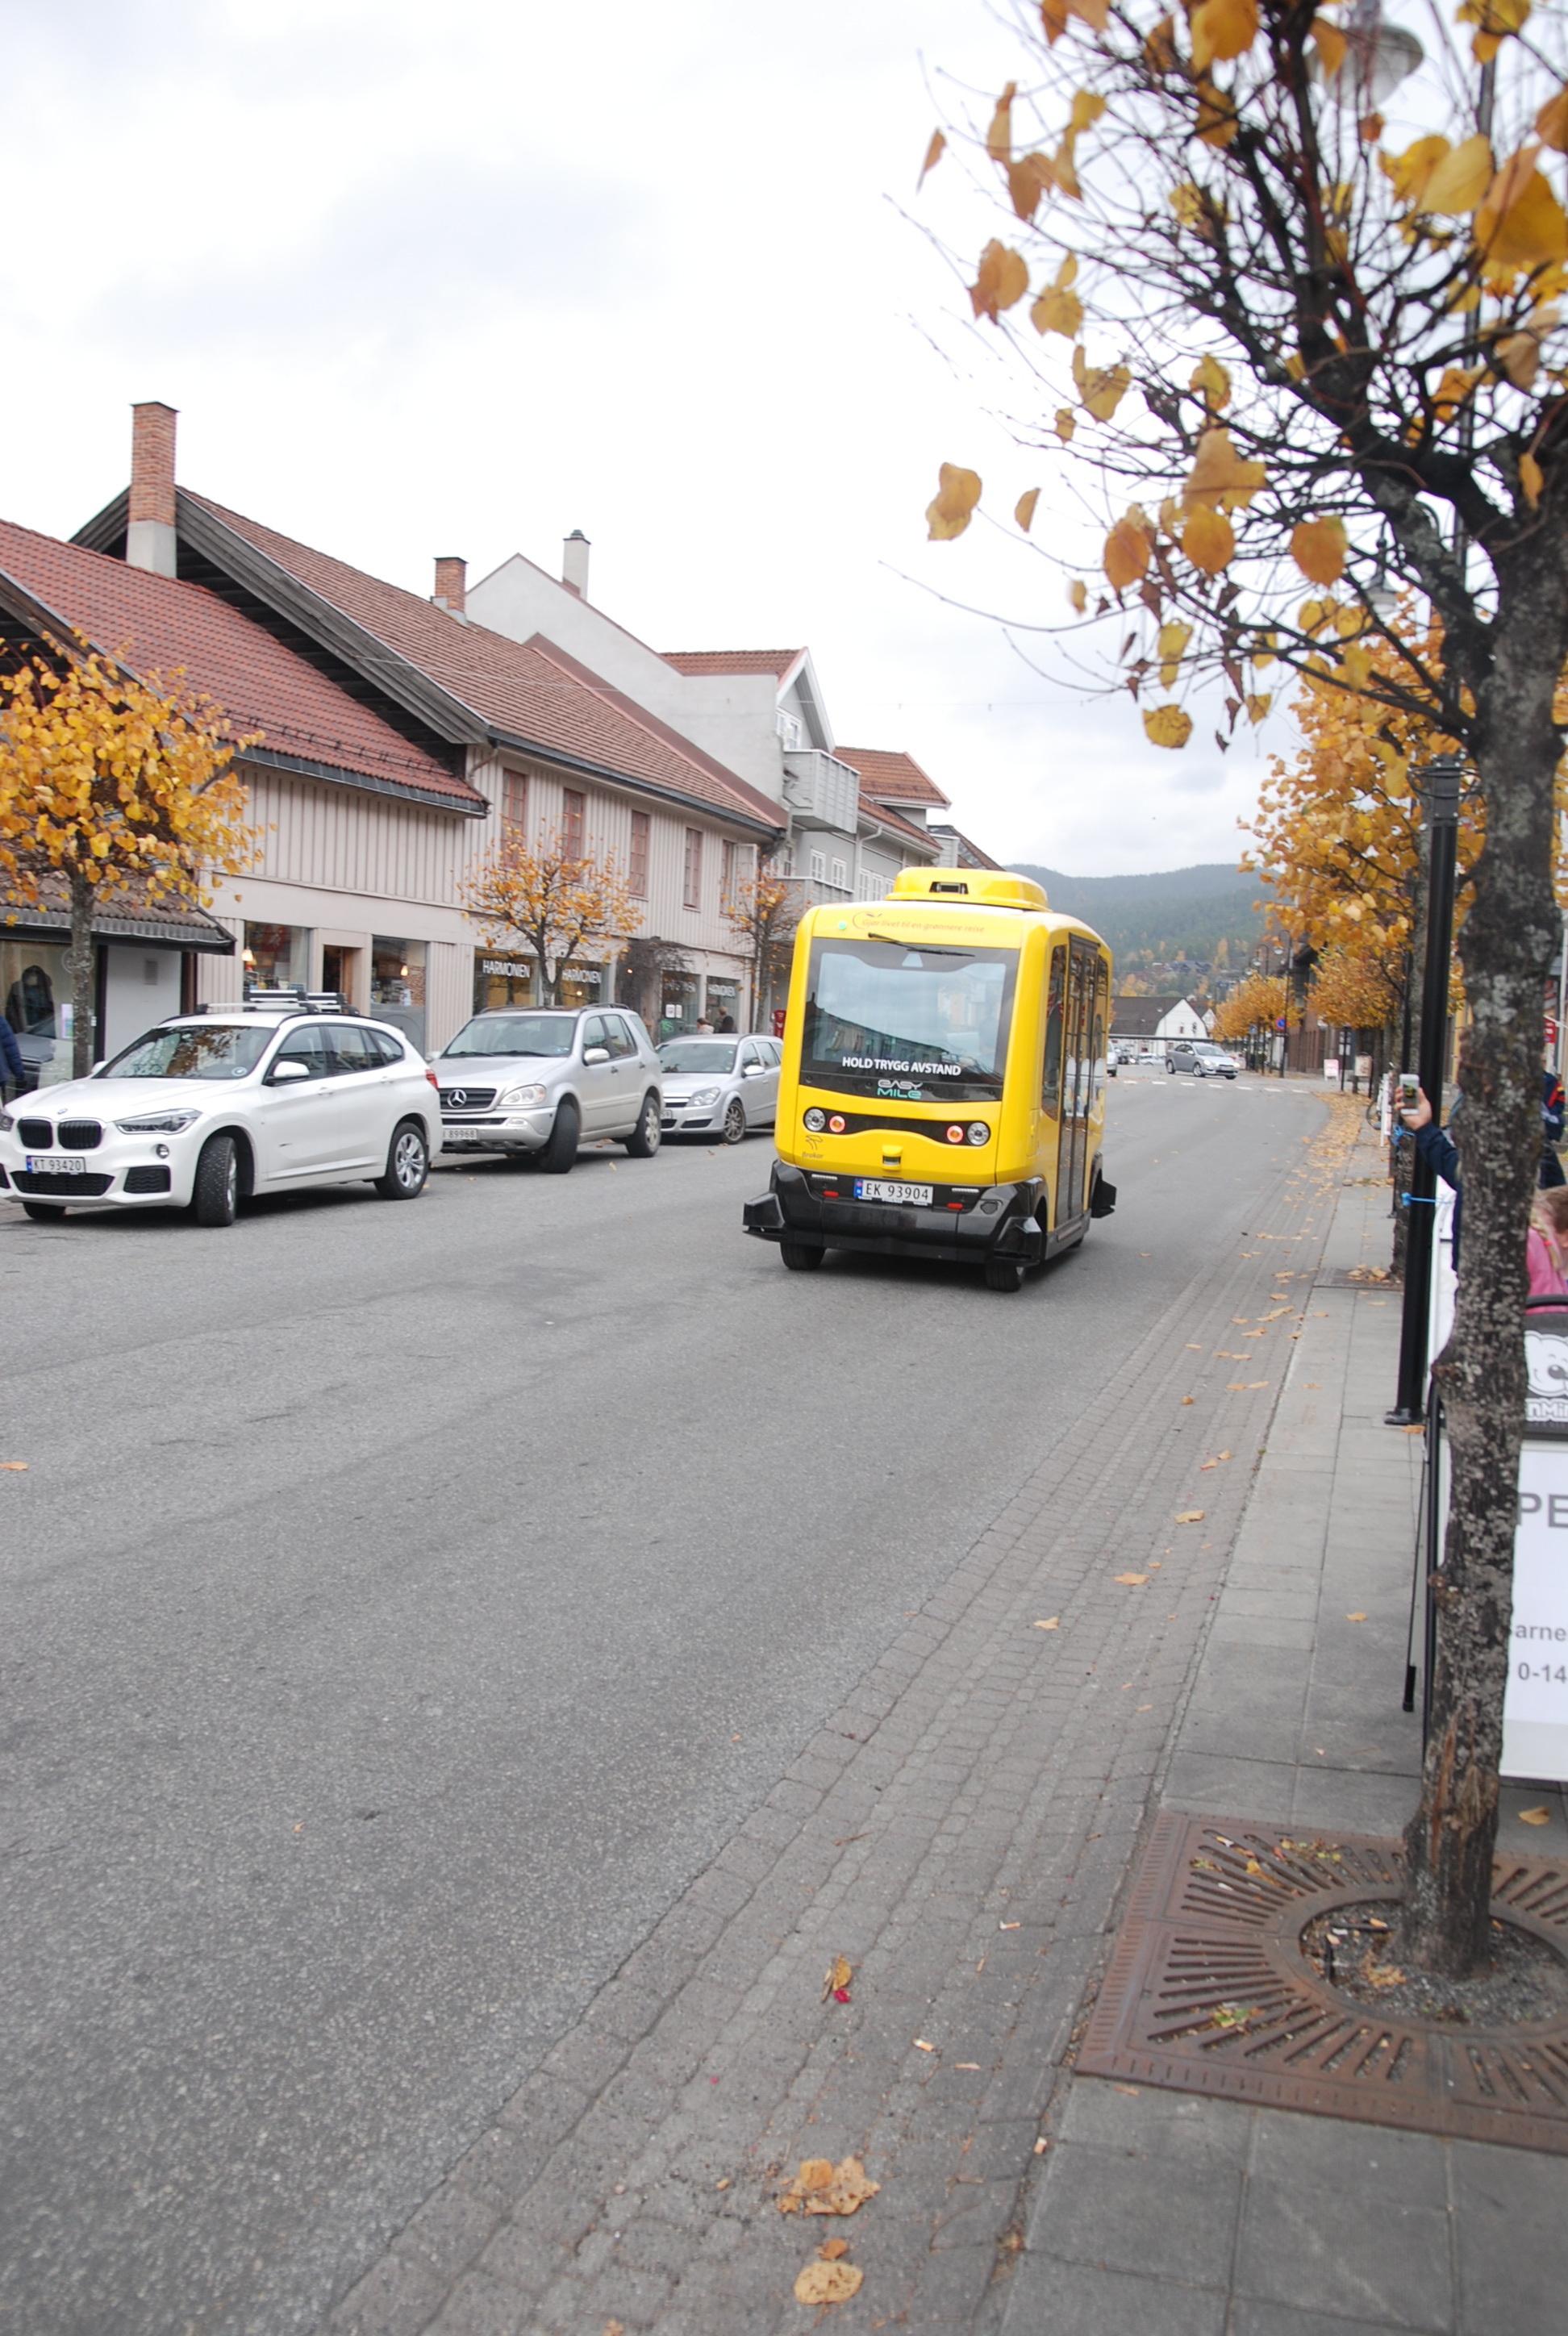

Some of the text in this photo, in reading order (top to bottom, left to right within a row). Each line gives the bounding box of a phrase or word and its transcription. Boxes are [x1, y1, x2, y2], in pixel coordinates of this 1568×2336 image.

[882, 920, 900, 928] livet
[901, 920, 911, 928] til
[924, 923, 962, 932] grønnere
[842, 1057, 961, 1076] HOLD TRYGG AVSTAND
[801, 1151, 824, 1159] Brakar
[33, 1159, 81, 1171] KT 93420
[865, 1183, 929, 1200] EK 93904
[1515, 1624, 1567, 1641] arne
